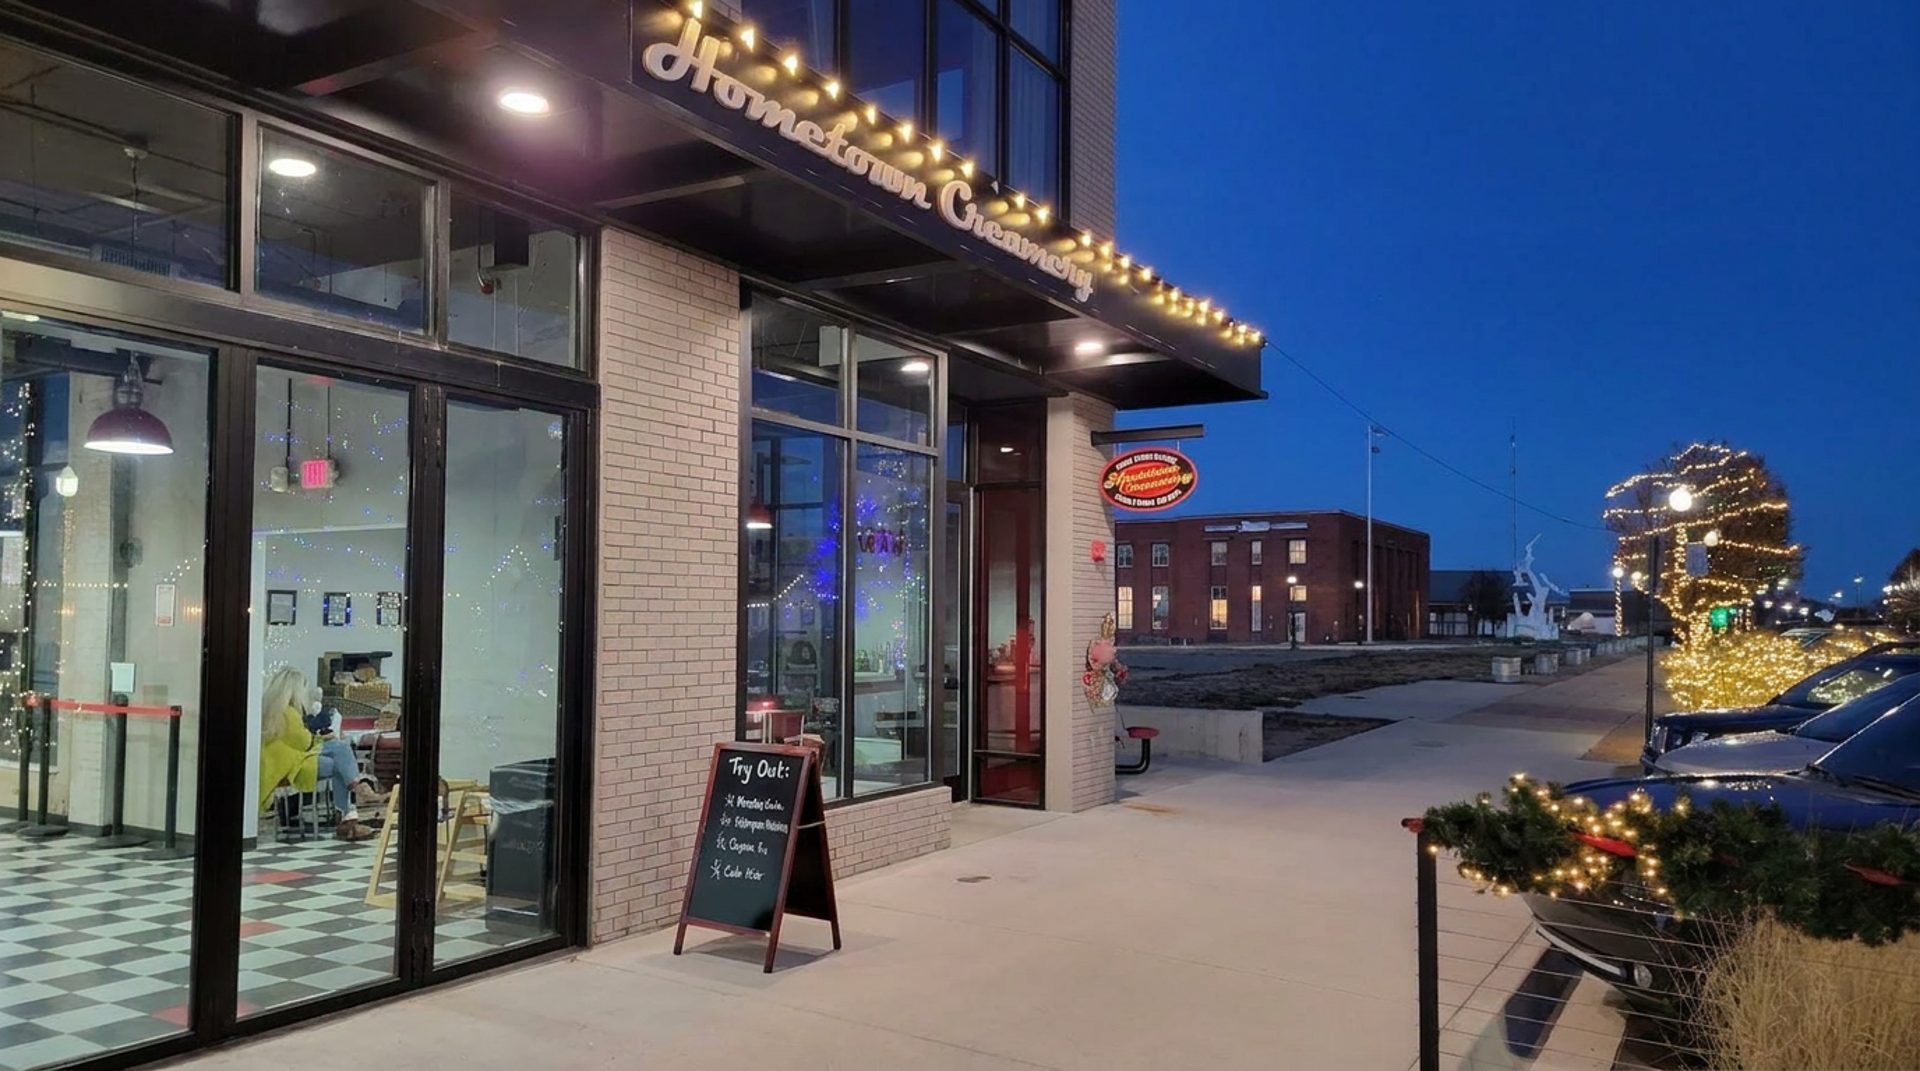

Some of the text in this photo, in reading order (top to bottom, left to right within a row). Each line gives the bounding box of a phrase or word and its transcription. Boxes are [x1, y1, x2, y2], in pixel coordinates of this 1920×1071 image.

[642, 17, 1094, 302] Hometown Creamery
[729, 756, 753, 785] Try
